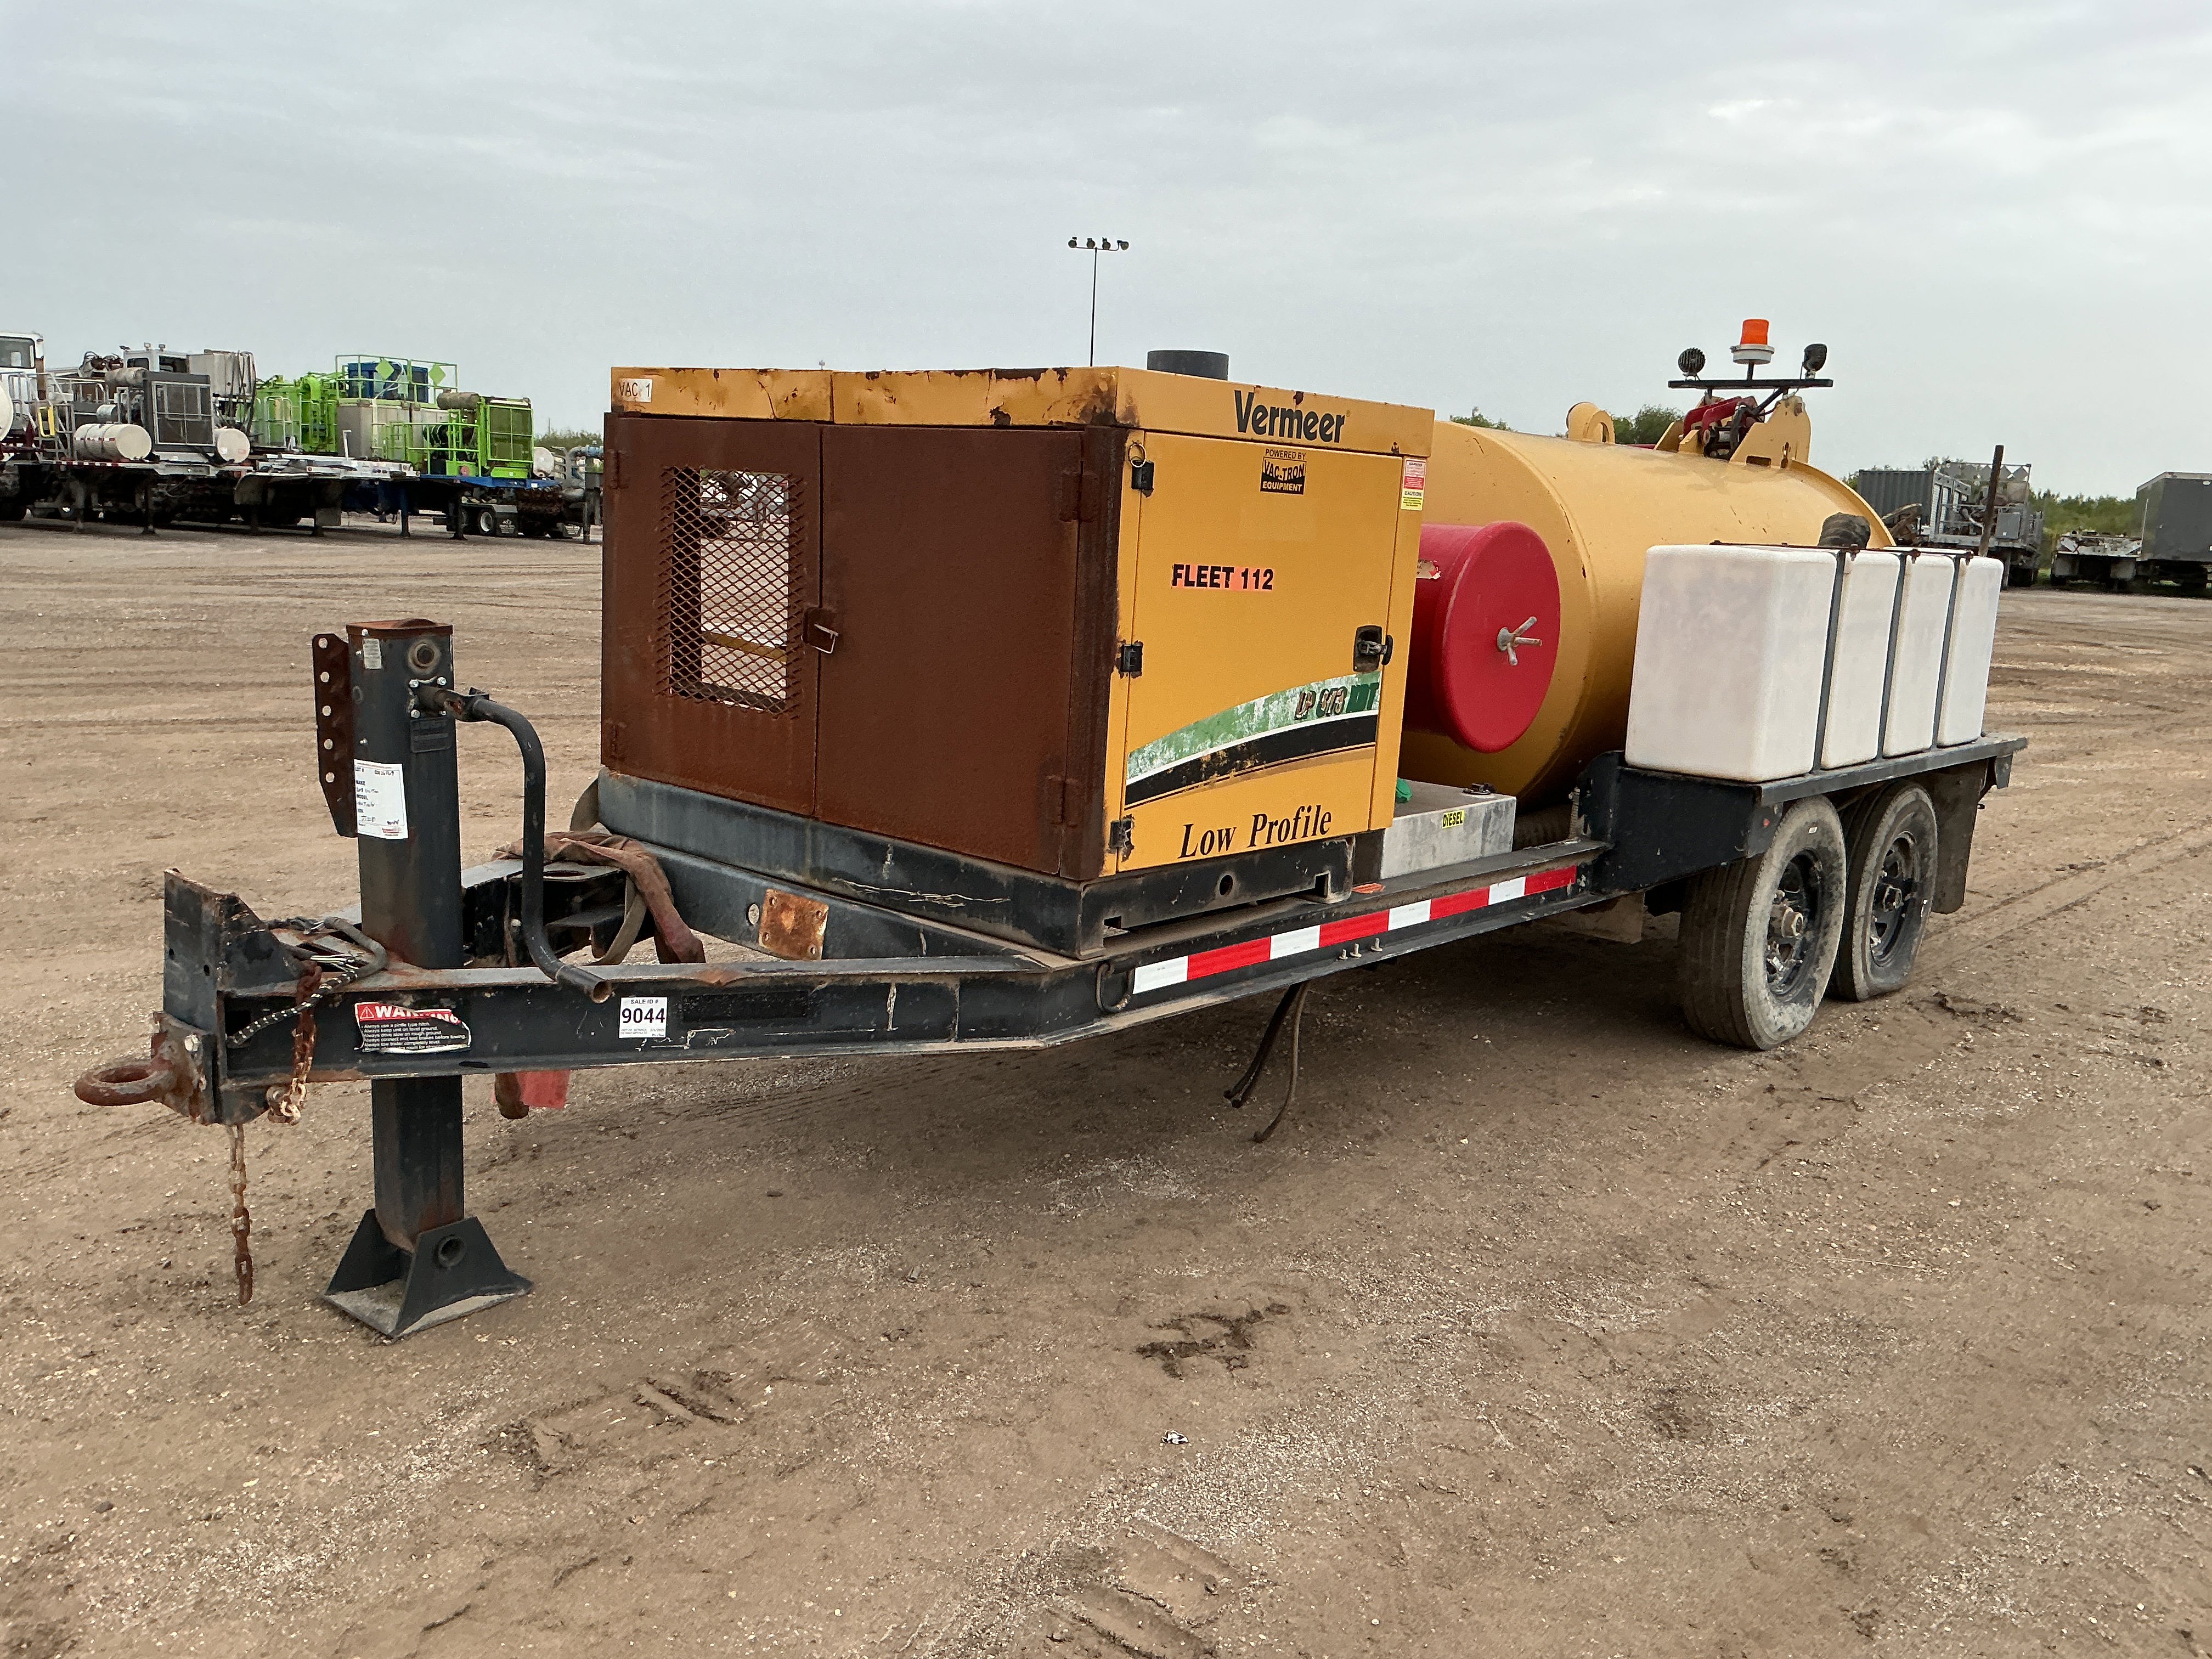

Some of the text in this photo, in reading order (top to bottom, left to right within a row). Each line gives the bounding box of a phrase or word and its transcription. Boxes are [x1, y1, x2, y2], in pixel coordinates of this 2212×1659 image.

[619, 382, 650, 397] VAC 1
[1234, 390, 1346, 443] Vermeer
[1265, 448, 1296, 459] POWERED
[1262, 481, 1302, 492] EQUIPMENT
[1172, 563, 1274, 590] FLEET 112
[1442, 811, 1463, 827] DIESEL
[1177, 804, 1332, 859] Low Profile
[622, 1008, 665, 1023] 9044
